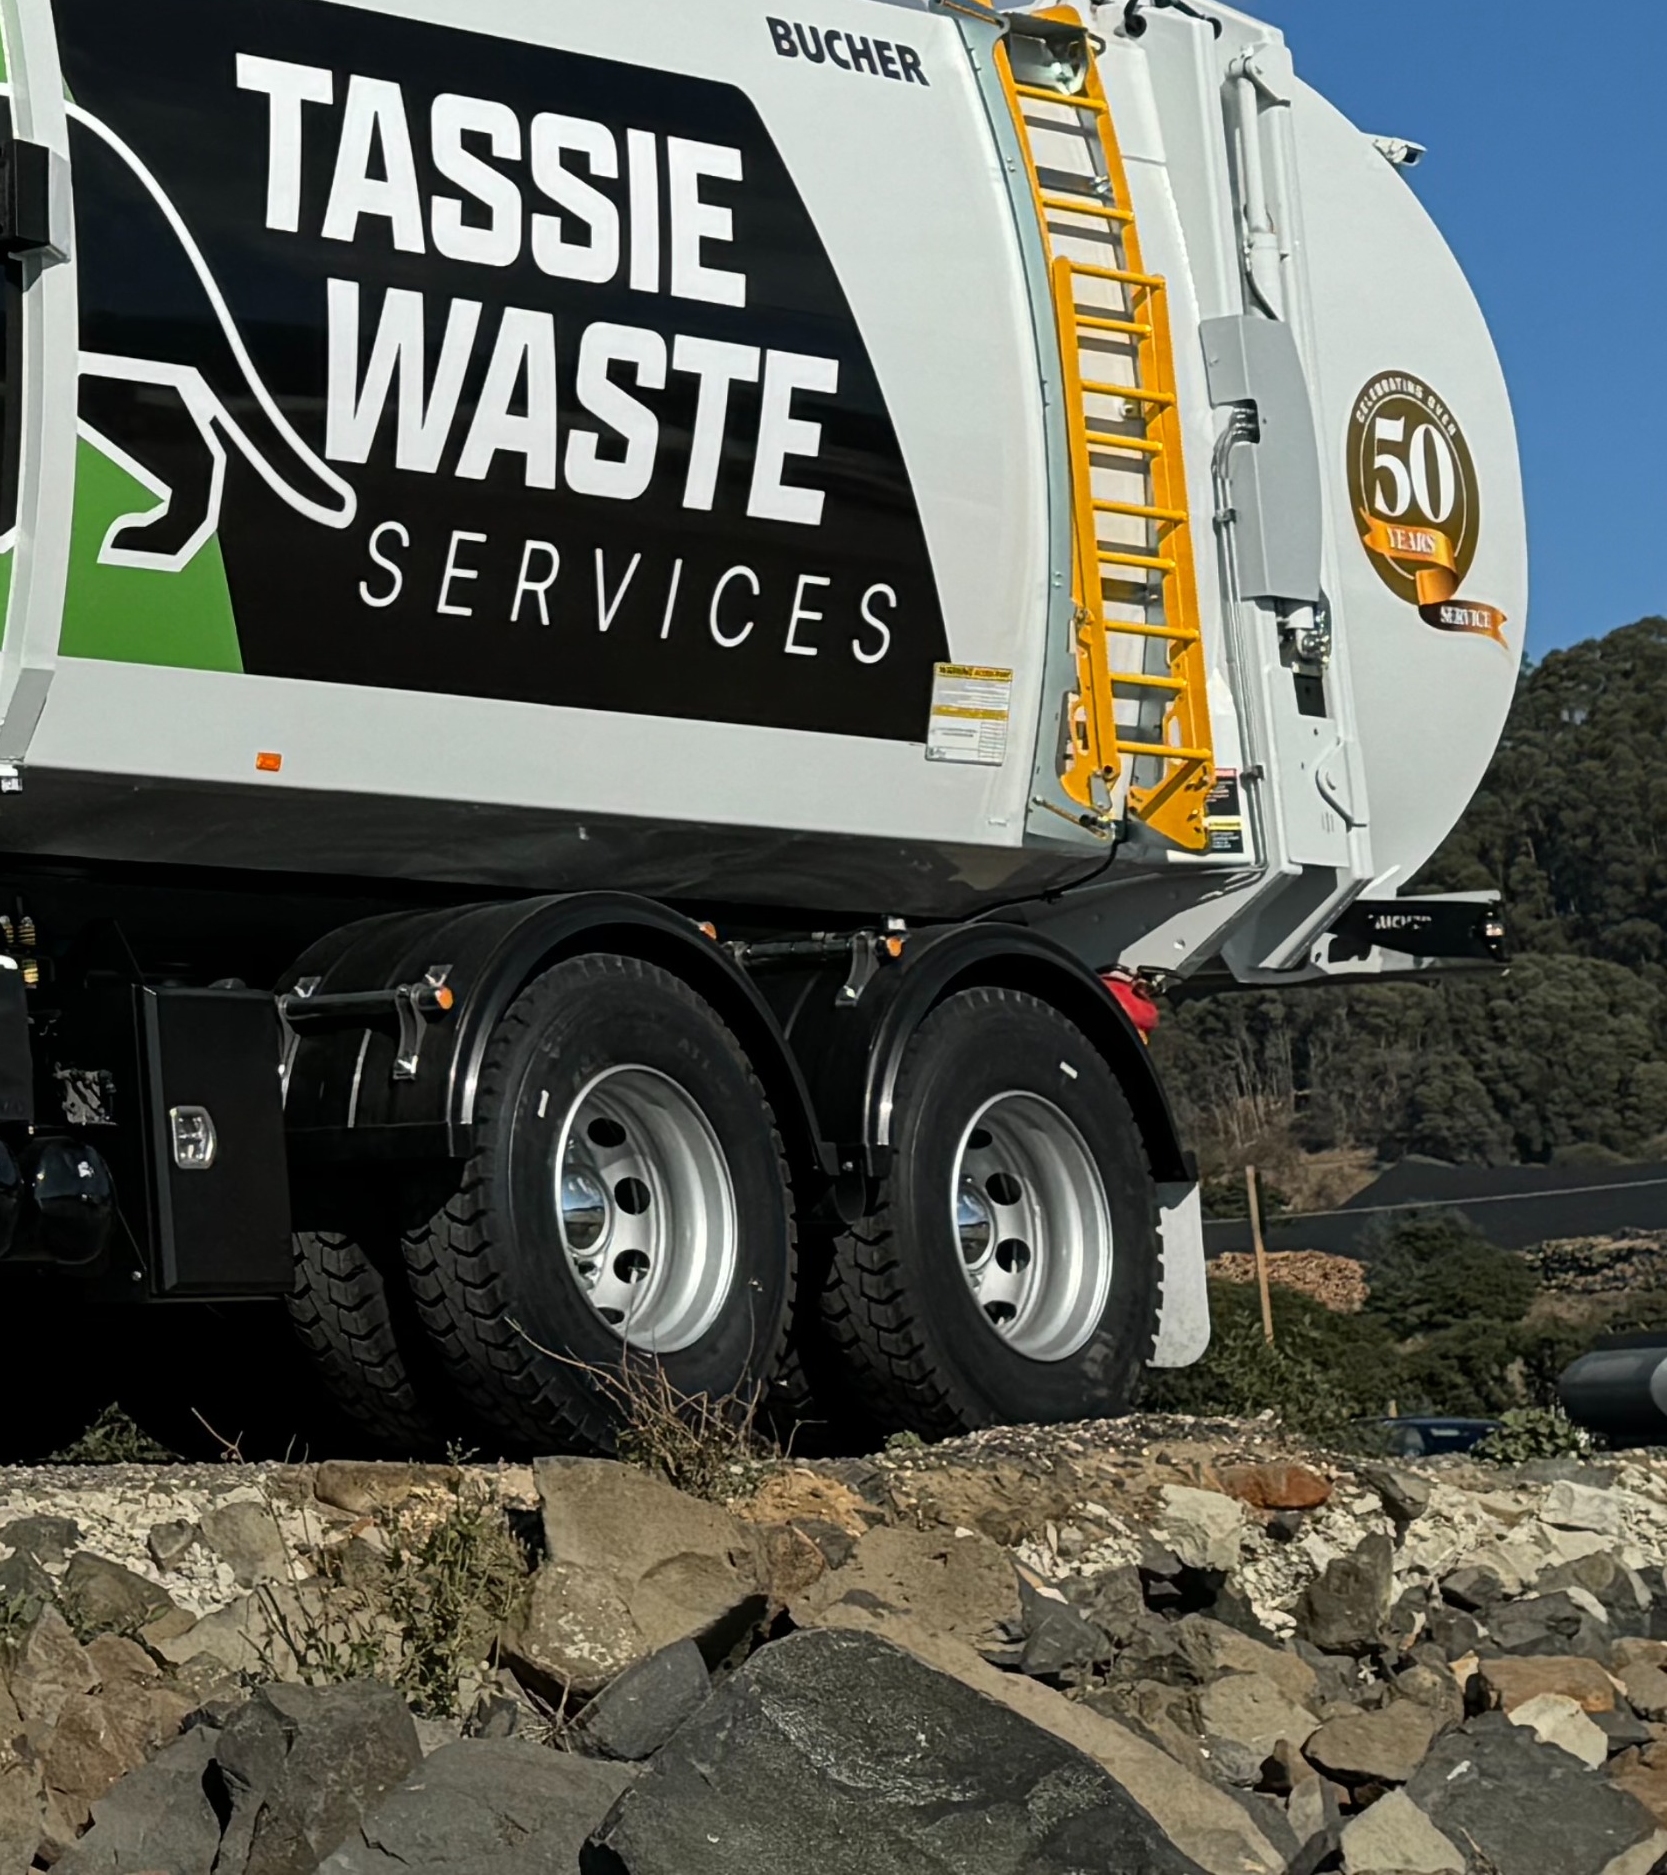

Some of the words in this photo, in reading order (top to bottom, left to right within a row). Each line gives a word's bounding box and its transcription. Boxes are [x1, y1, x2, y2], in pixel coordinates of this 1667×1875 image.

[765, 15, 930, 87] BUCHER
[235, 52, 746, 309] TASSIE
[324, 277, 839, 526] WASTE
[1373, 415, 1456, 523] 50
[359, 520, 898, 664] SERVICES
[1386, 527, 1436, 555] YEARS
[1439, 605, 1492, 629] SERVICE
